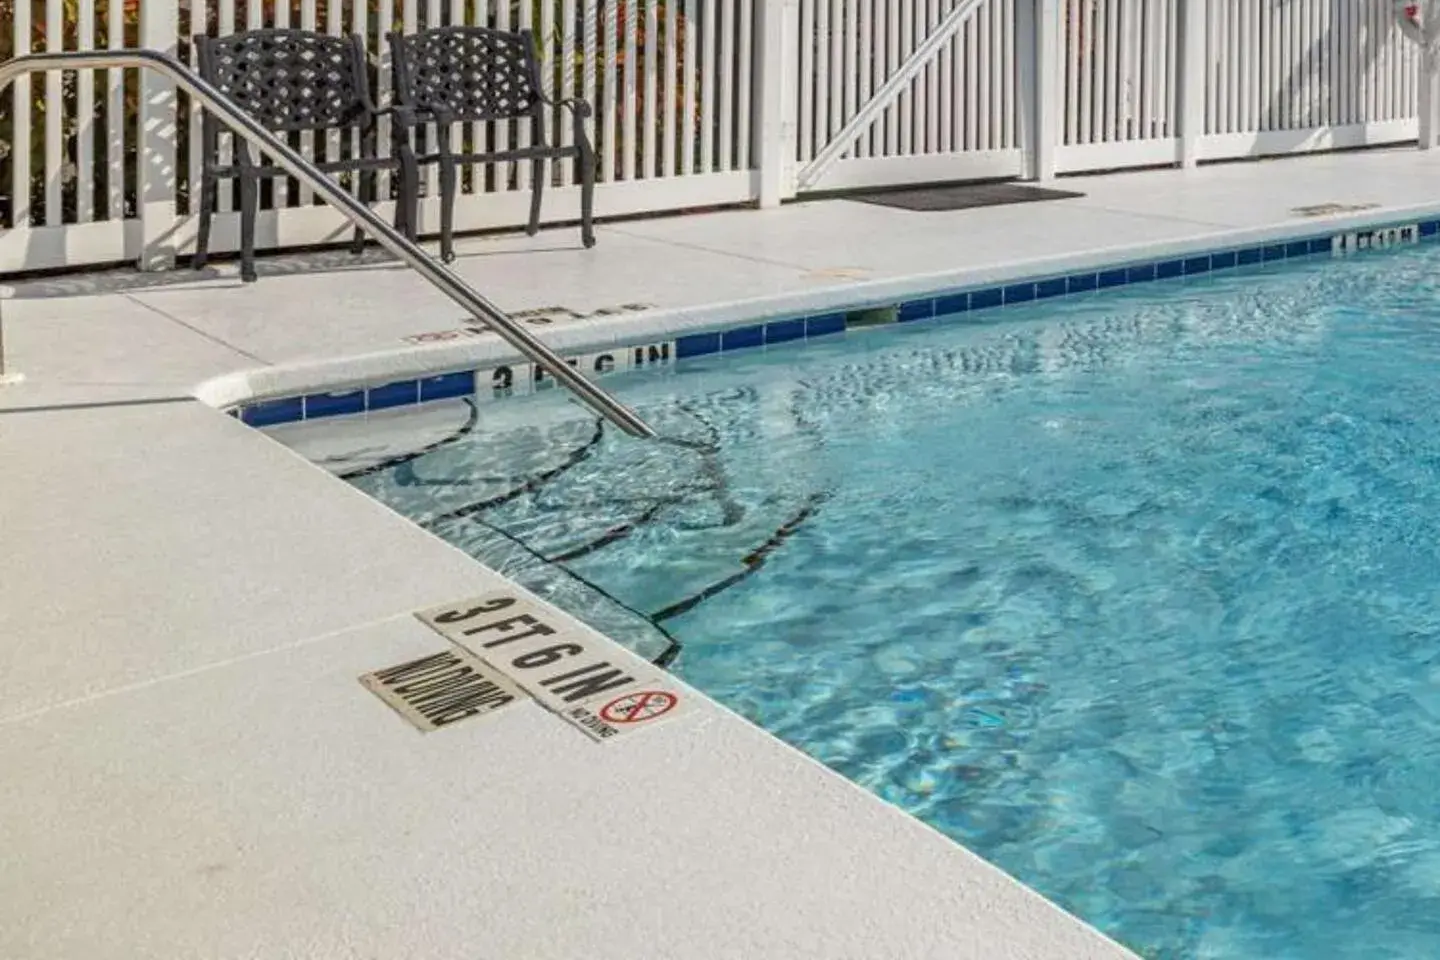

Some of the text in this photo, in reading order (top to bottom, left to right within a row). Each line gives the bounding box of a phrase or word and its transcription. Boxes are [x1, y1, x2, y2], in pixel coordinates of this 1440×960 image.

[373, 650, 516, 727] NO DIVING
[434, 597, 635, 703] 3 FT 6 IN
